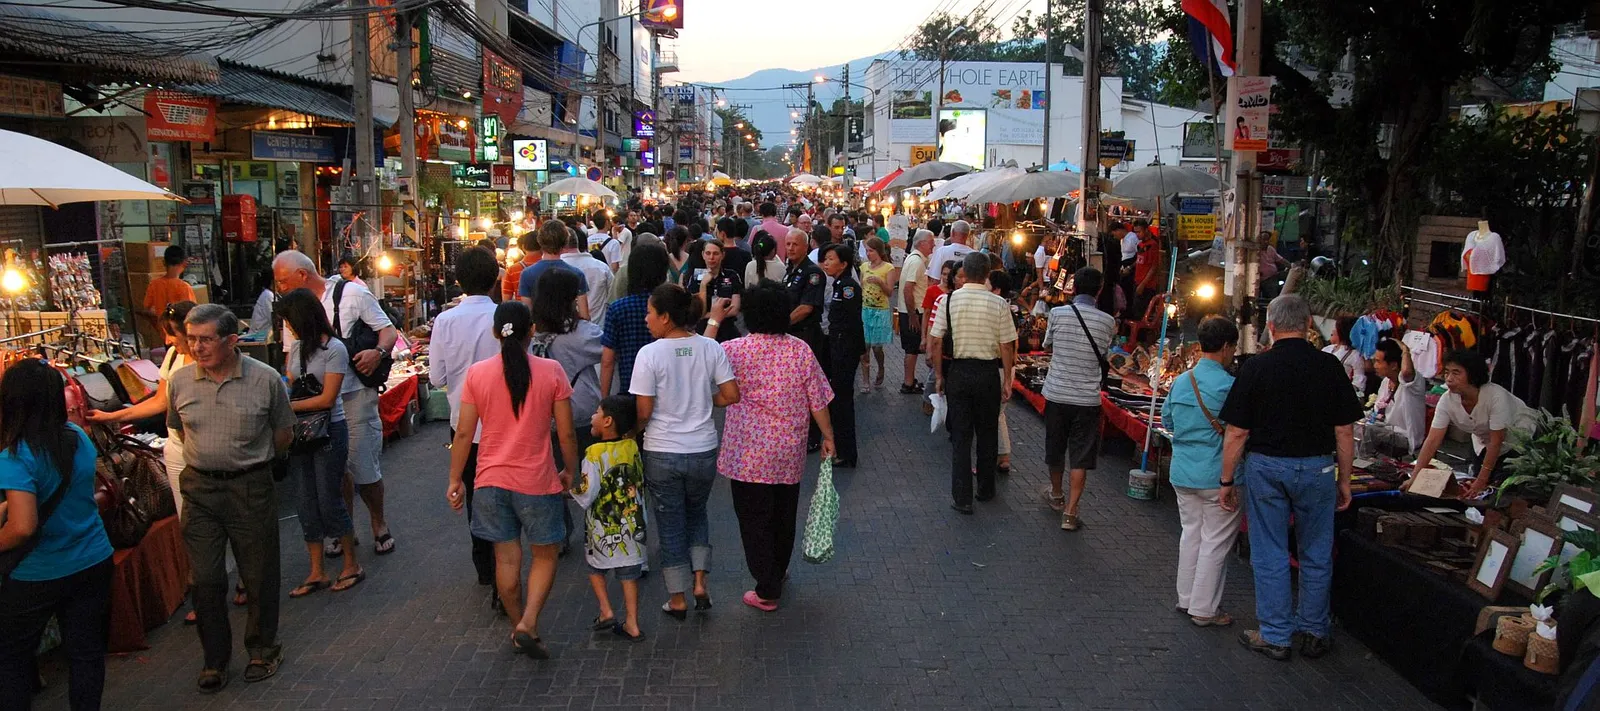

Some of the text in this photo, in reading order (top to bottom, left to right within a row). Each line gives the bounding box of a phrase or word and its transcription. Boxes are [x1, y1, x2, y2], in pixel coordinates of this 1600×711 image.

[892, 67, 1046, 86] THE WHOLE EARTH
